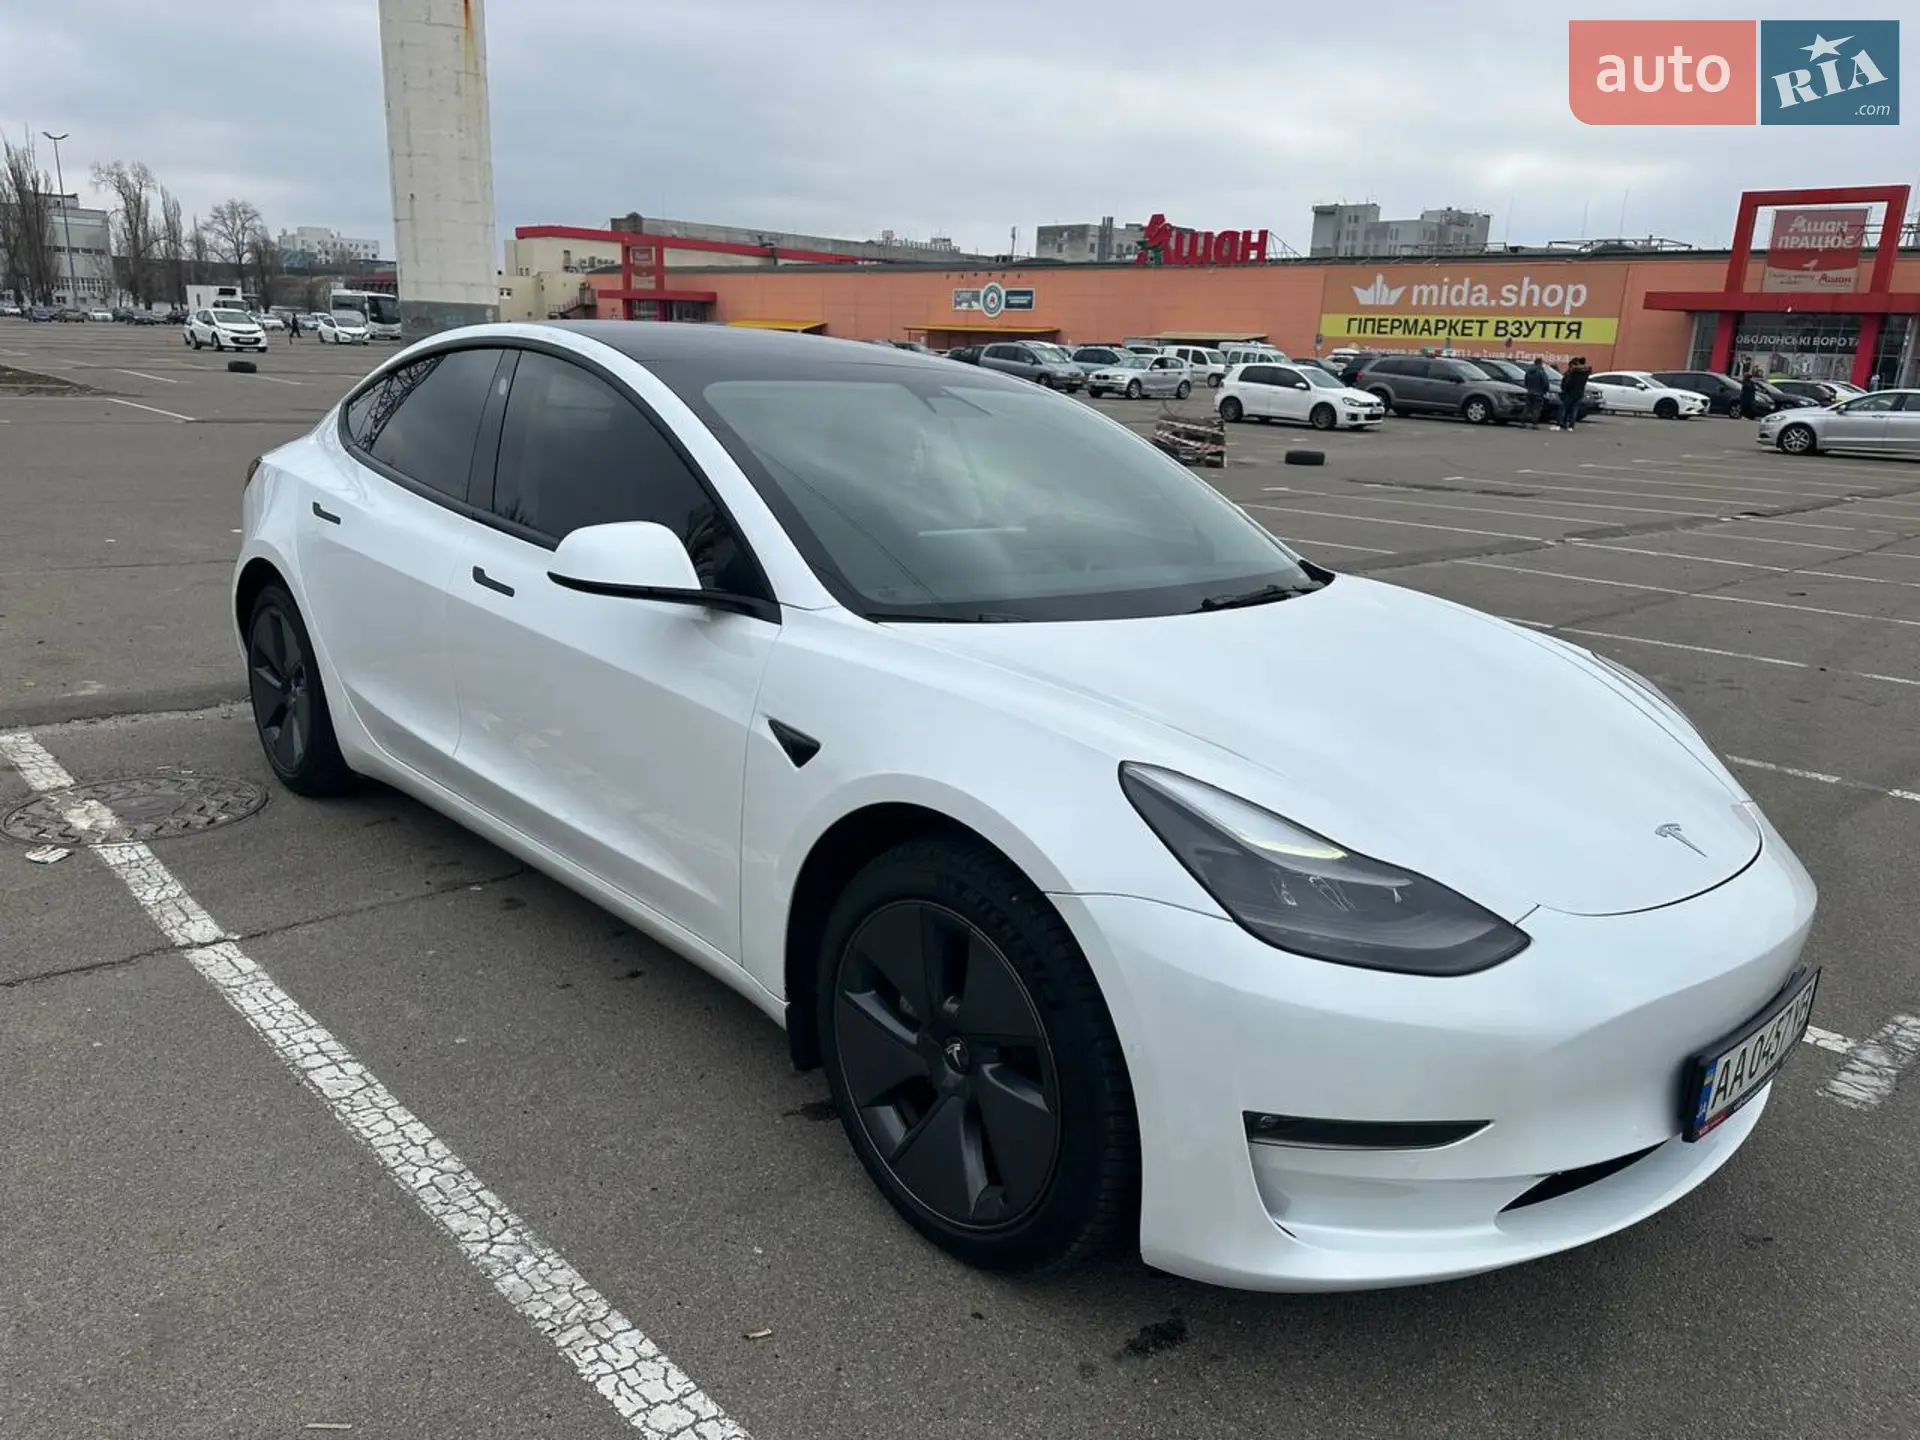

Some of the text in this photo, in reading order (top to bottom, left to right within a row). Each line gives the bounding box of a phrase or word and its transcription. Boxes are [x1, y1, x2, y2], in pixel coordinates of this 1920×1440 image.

[1410, 276, 1588, 315] mida.shop
[1346, 317, 1583, 340] ГІПЕРМАРКЕТ ВЗУТТЯ
[1736, 333, 1811, 346] ОБОЛОНСЬКІ
[1711, 1047, 1747, 1109] AA
[1749, 1004, 1795, 1080] 0457
